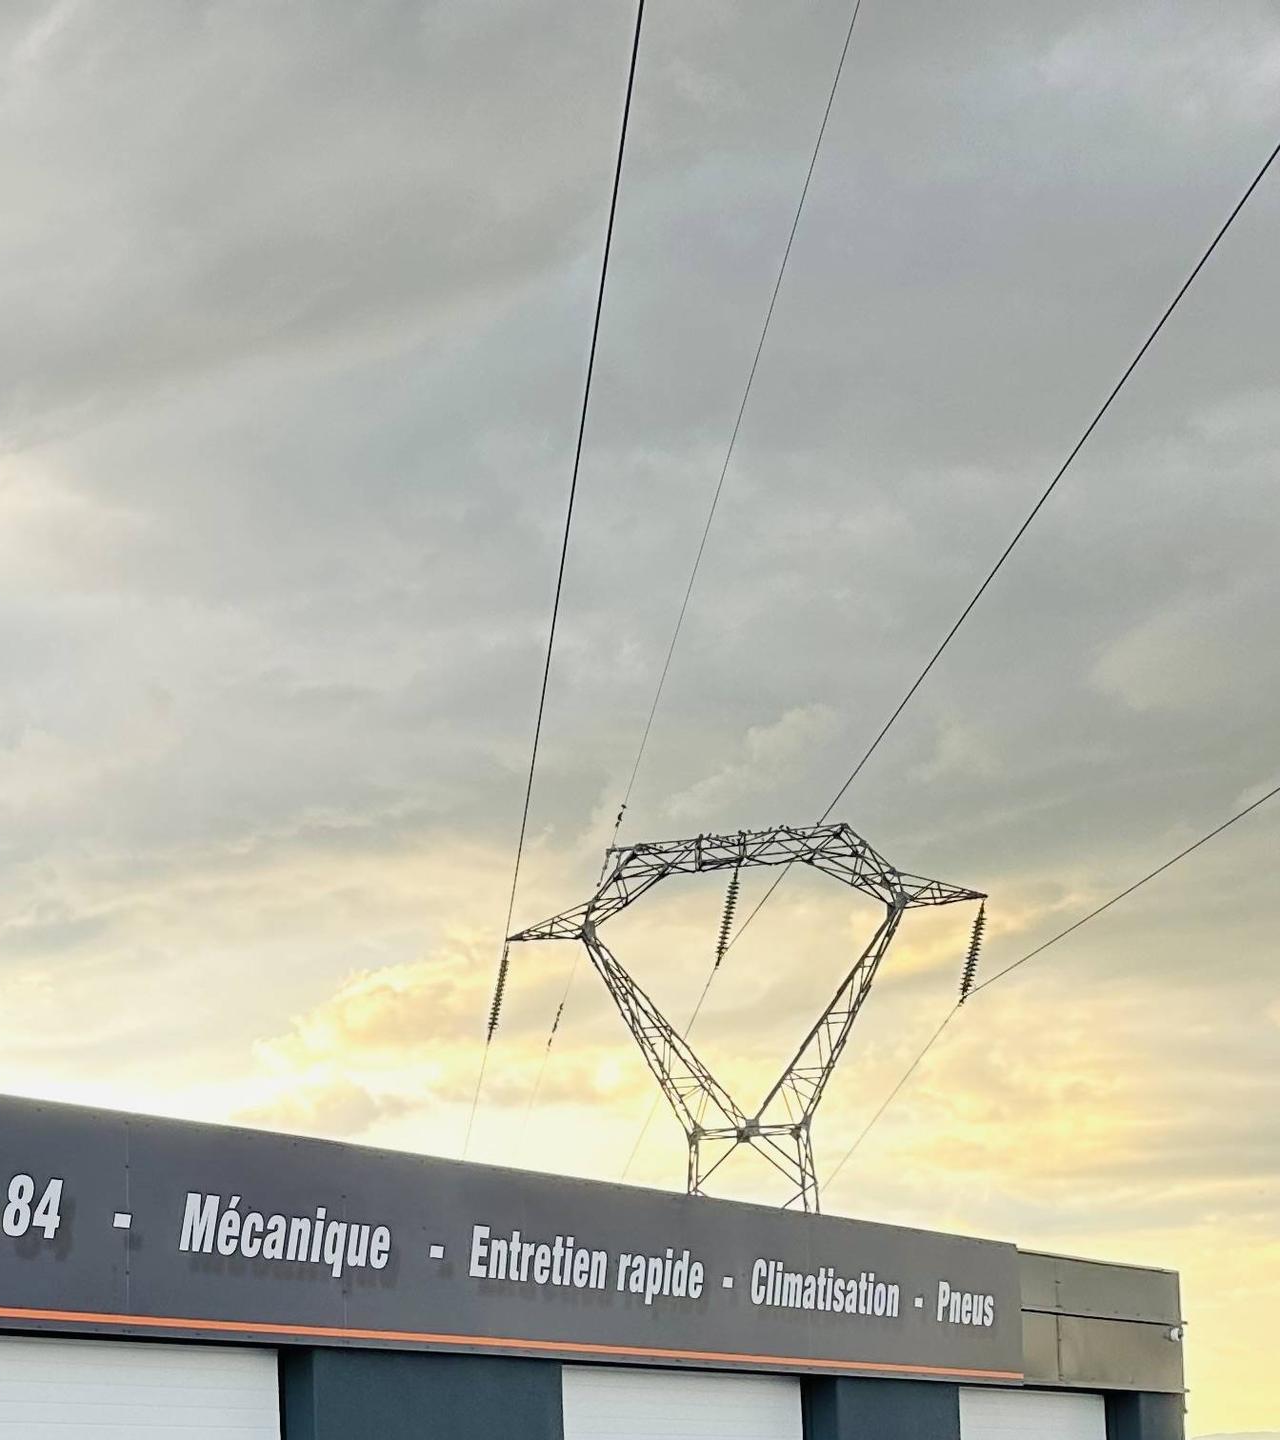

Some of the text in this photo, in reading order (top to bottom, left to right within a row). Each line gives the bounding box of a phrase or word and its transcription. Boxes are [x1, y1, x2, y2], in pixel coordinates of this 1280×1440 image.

[2, 1173, 64, 1240] 84
[178, 1191, 391, 1278] Mécanique
[469, 1224, 608, 1290] Entretien
[616, 1248, 704, 1305] rapide
[750, 1258, 900, 1318] Climatisation
[936, 1280, 994, 1327] Pneus
